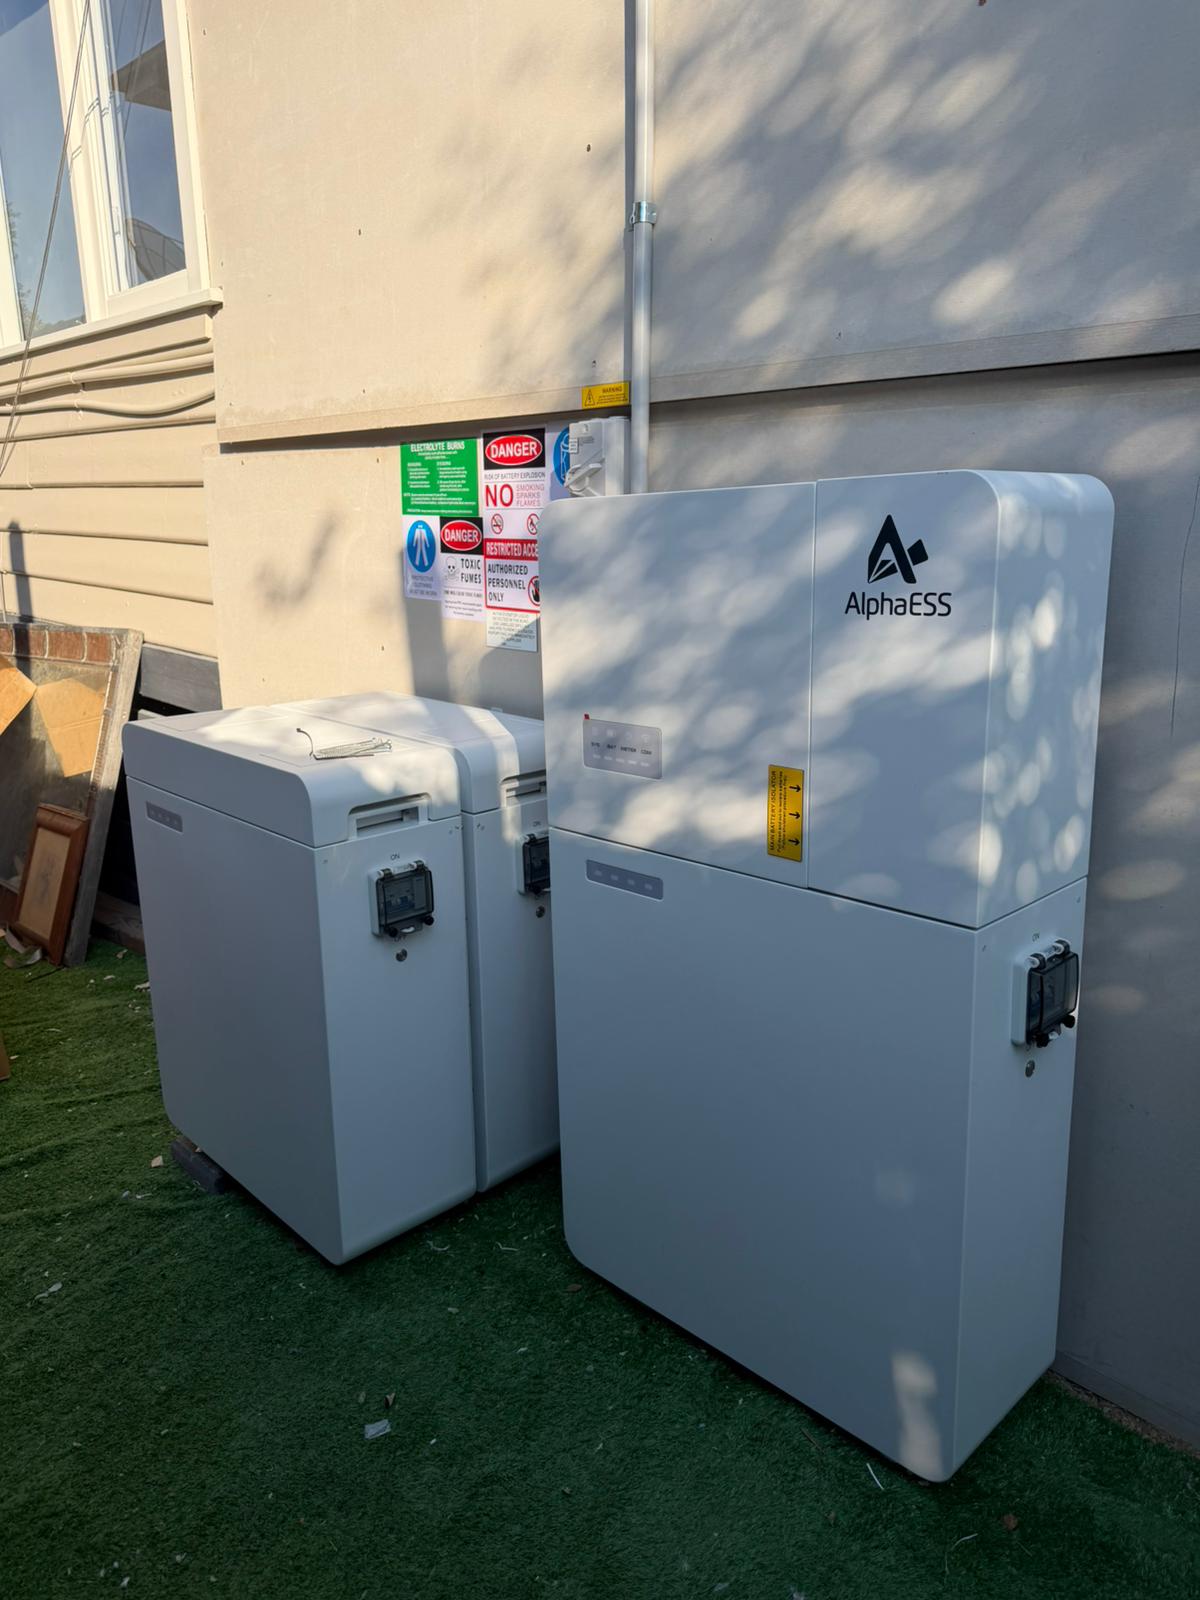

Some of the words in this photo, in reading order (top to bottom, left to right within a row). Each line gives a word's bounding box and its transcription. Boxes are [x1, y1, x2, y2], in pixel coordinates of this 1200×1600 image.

[410, 442, 445, 452] ELECTROLYTE
[447, 440, 465, 450] BURNS
[490, 442, 537, 459] DANGER
[500, 472, 520, 480] BATTERY
[520, 471, 546, 479] EXPLOSION
[485, 483, 514, 507] NO
[444, 528, 479, 542] DANGER
[486, 541, 522, 557] RESTRICTED
[460, 558, 481, 570] TOXIC
[488, 563, 529, 575] AUTHORIZED
[460, 572, 482, 584] FUMES
[488, 577, 526, 590] PERSONNEL
[488, 591, 504, 602] ONLY
[844, 591, 953, 621] AlphaESS
